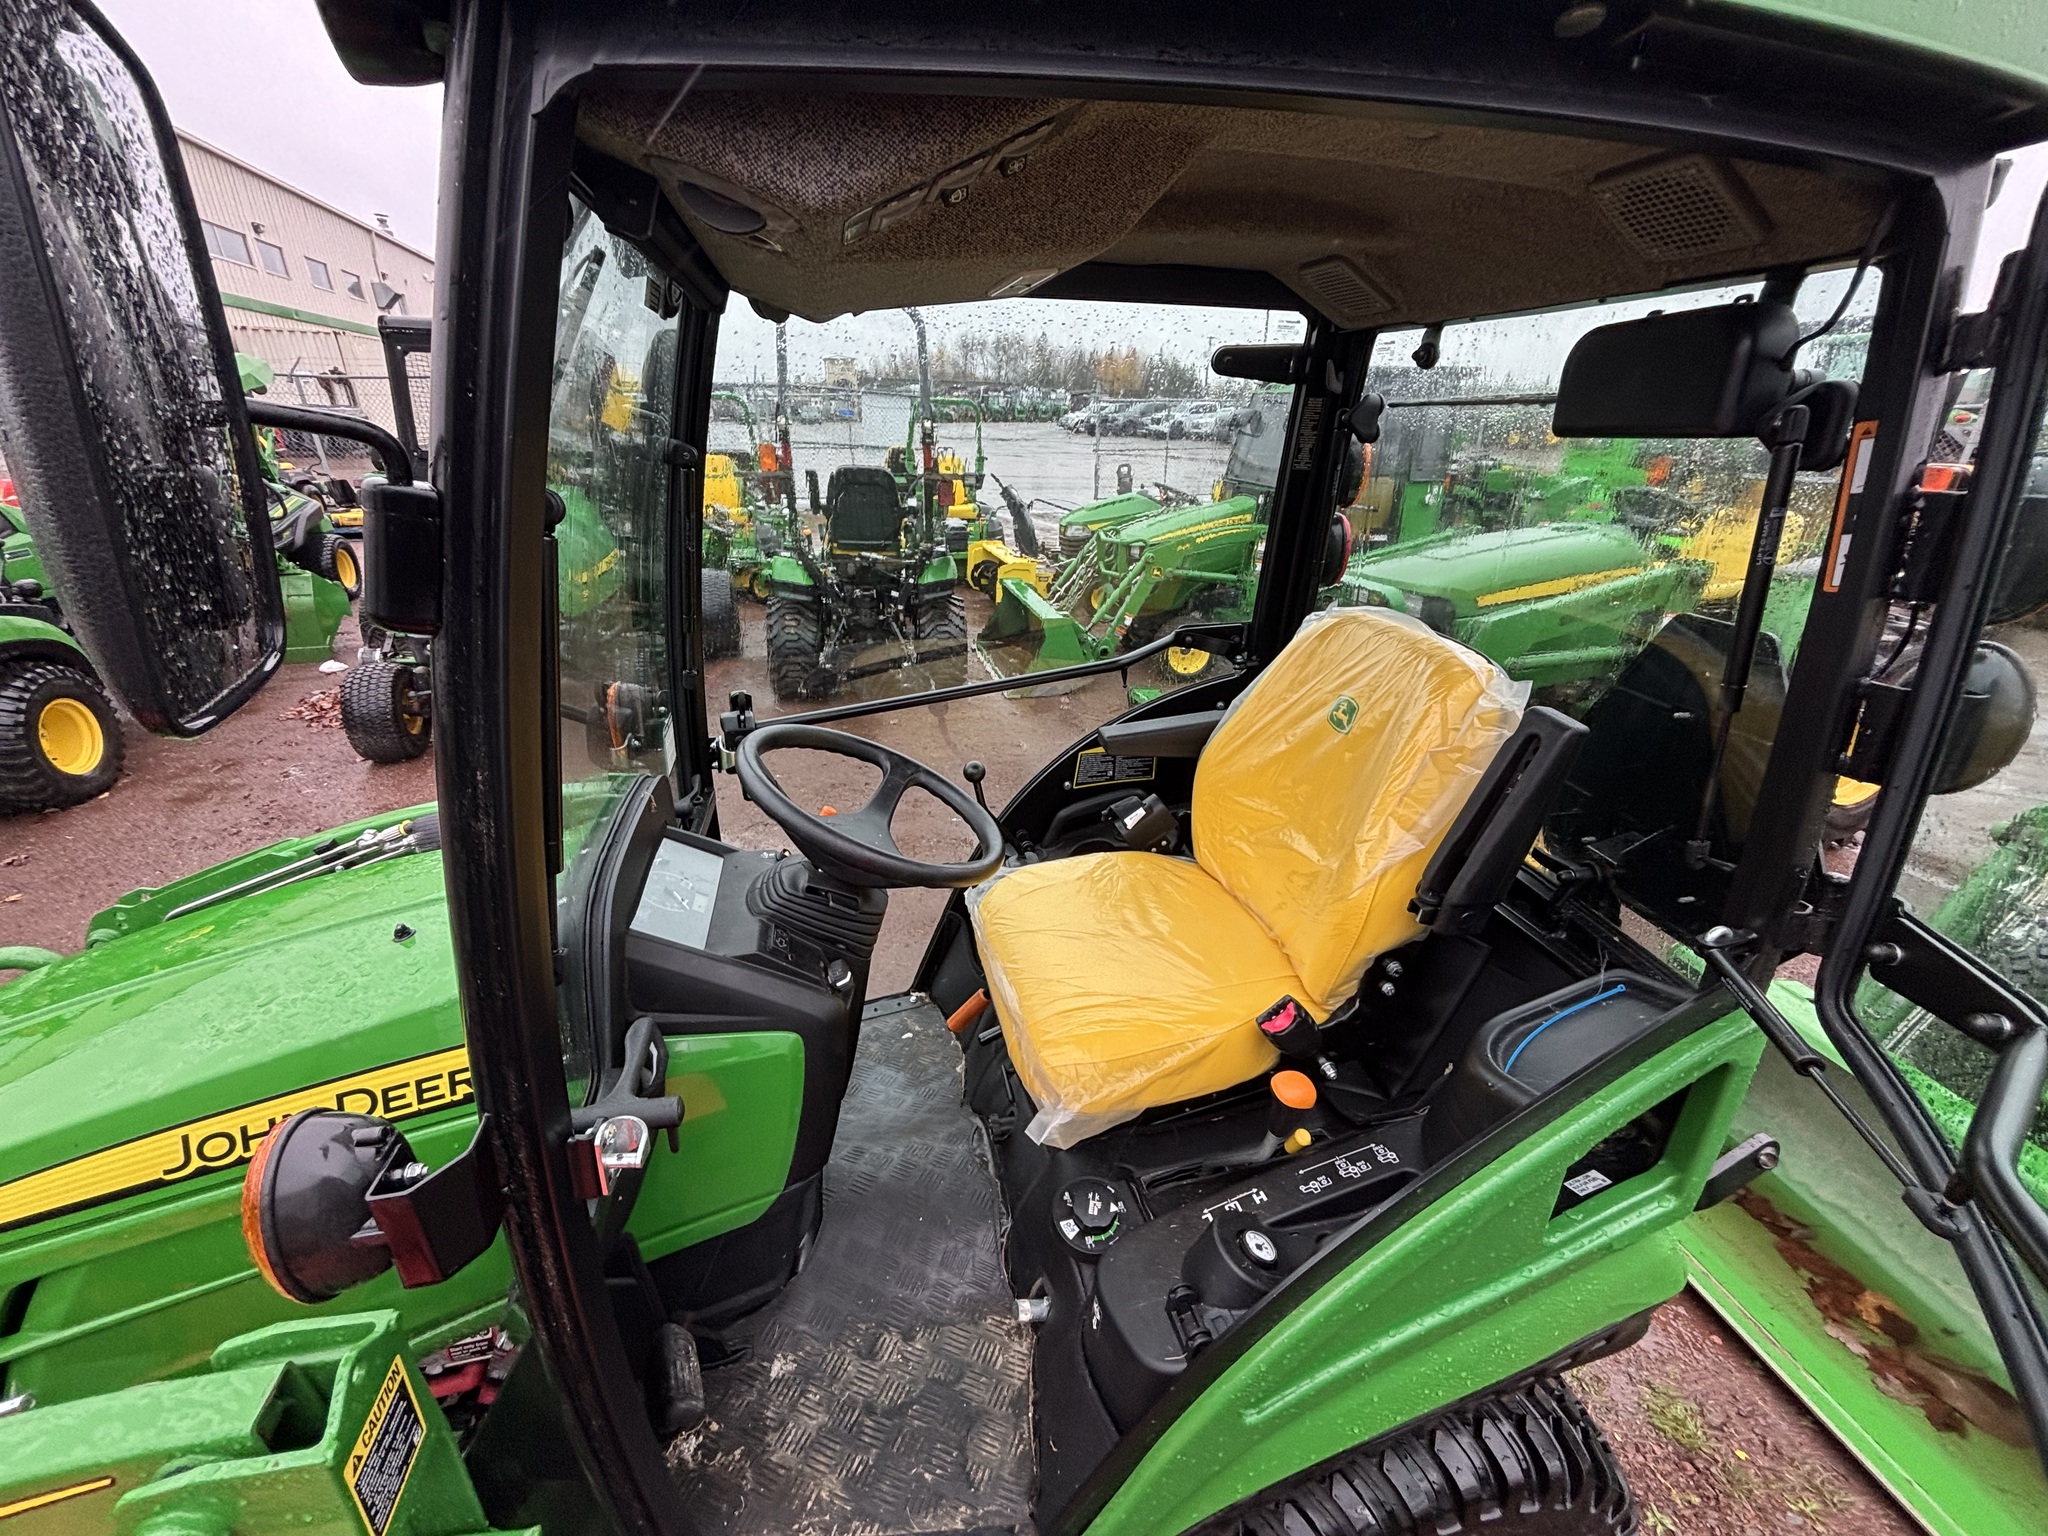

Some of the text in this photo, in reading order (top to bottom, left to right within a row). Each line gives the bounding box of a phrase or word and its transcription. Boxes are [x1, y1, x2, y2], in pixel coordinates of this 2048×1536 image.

[162, 1066, 473, 1176] JOH DEER
[1252, 1190, 1268, 1204] H
[361, 1362, 401, 1449] CAUTION
